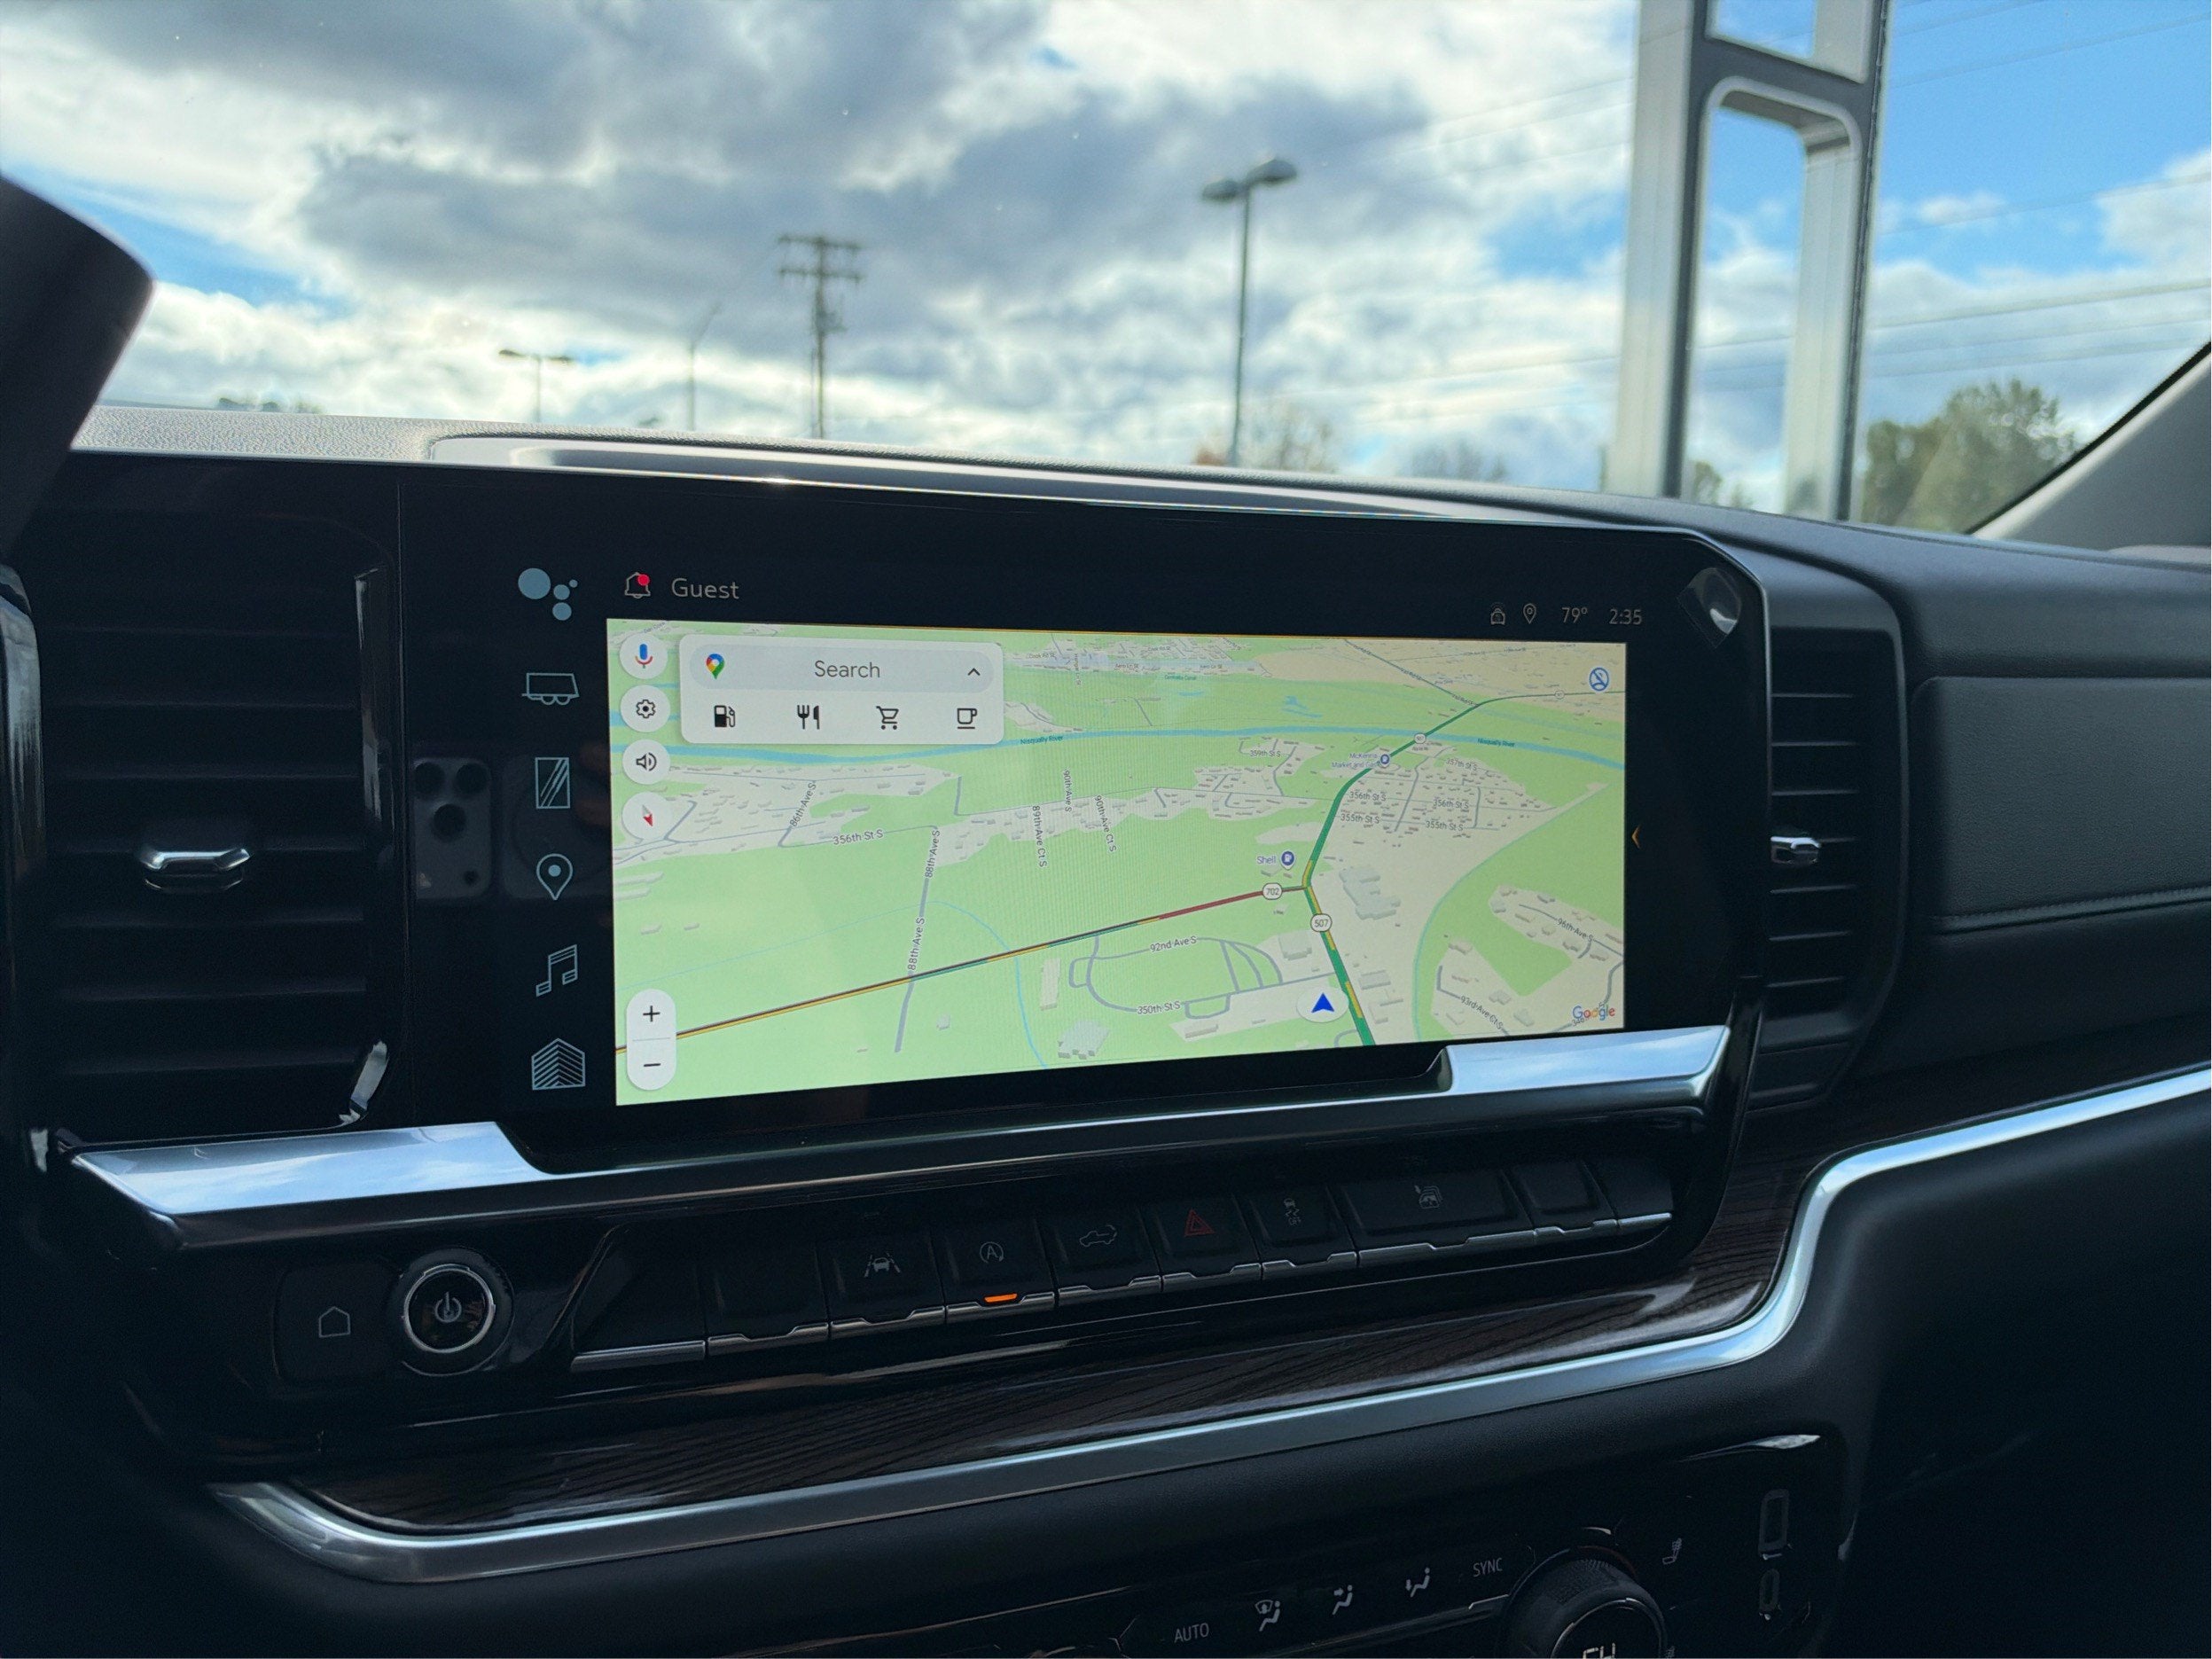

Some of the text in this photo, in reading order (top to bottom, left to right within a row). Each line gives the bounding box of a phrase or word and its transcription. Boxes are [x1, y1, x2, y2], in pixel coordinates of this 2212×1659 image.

[671, 577, 740, 600] Guest
[1608, 608, 1642, 625] 2:35
[814, 660, 880, 678] Search
[1063, 770, 1073, 789] 90th
[801, 790, 814, 808] Ave
[1349, 791, 1371, 800] 356th
[1456, 800, 1463, 809] St
[1032, 805, 1043, 826] 89th
[1094, 794, 1106, 816] 90th
[1101, 818, 1110, 833] Ave
[1106, 833, 1114, 844] Ct
[1340, 813, 1364, 822] 355th
[1365, 815, 1372, 824] St
[1426, 820, 1447, 830] 355th
[832, 829, 884, 845] 356th St S
[929, 838, 938, 856] Ave
[1037, 848, 1046, 858] Ct
[925, 857, 935, 878] 88th
[1256, 855, 1277, 865] Shell
[1314, 919, 1328, 927] 507
[1558, 918, 1573, 931] 96th
[1575, 927, 1587, 938] Ave
[908, 917, 926, 970] 88th Ave S
[1150, 940, 1172, 952] 92nd
[1174, 938, 1190, 947] Ave
[1137, 1000, 1181, 1015] 350th St S
[1461, 995, 1477, 1009] 93rd
[1476, 1006, 1490, 1018] Ave
[1489, 1014, 1498, 1025] Ct
[1572, 1004, 1615, 1021] Google
[1472, 1557, 1503, 1578] SYNC
[1174, 1622, 1209, 1643] AUTO
